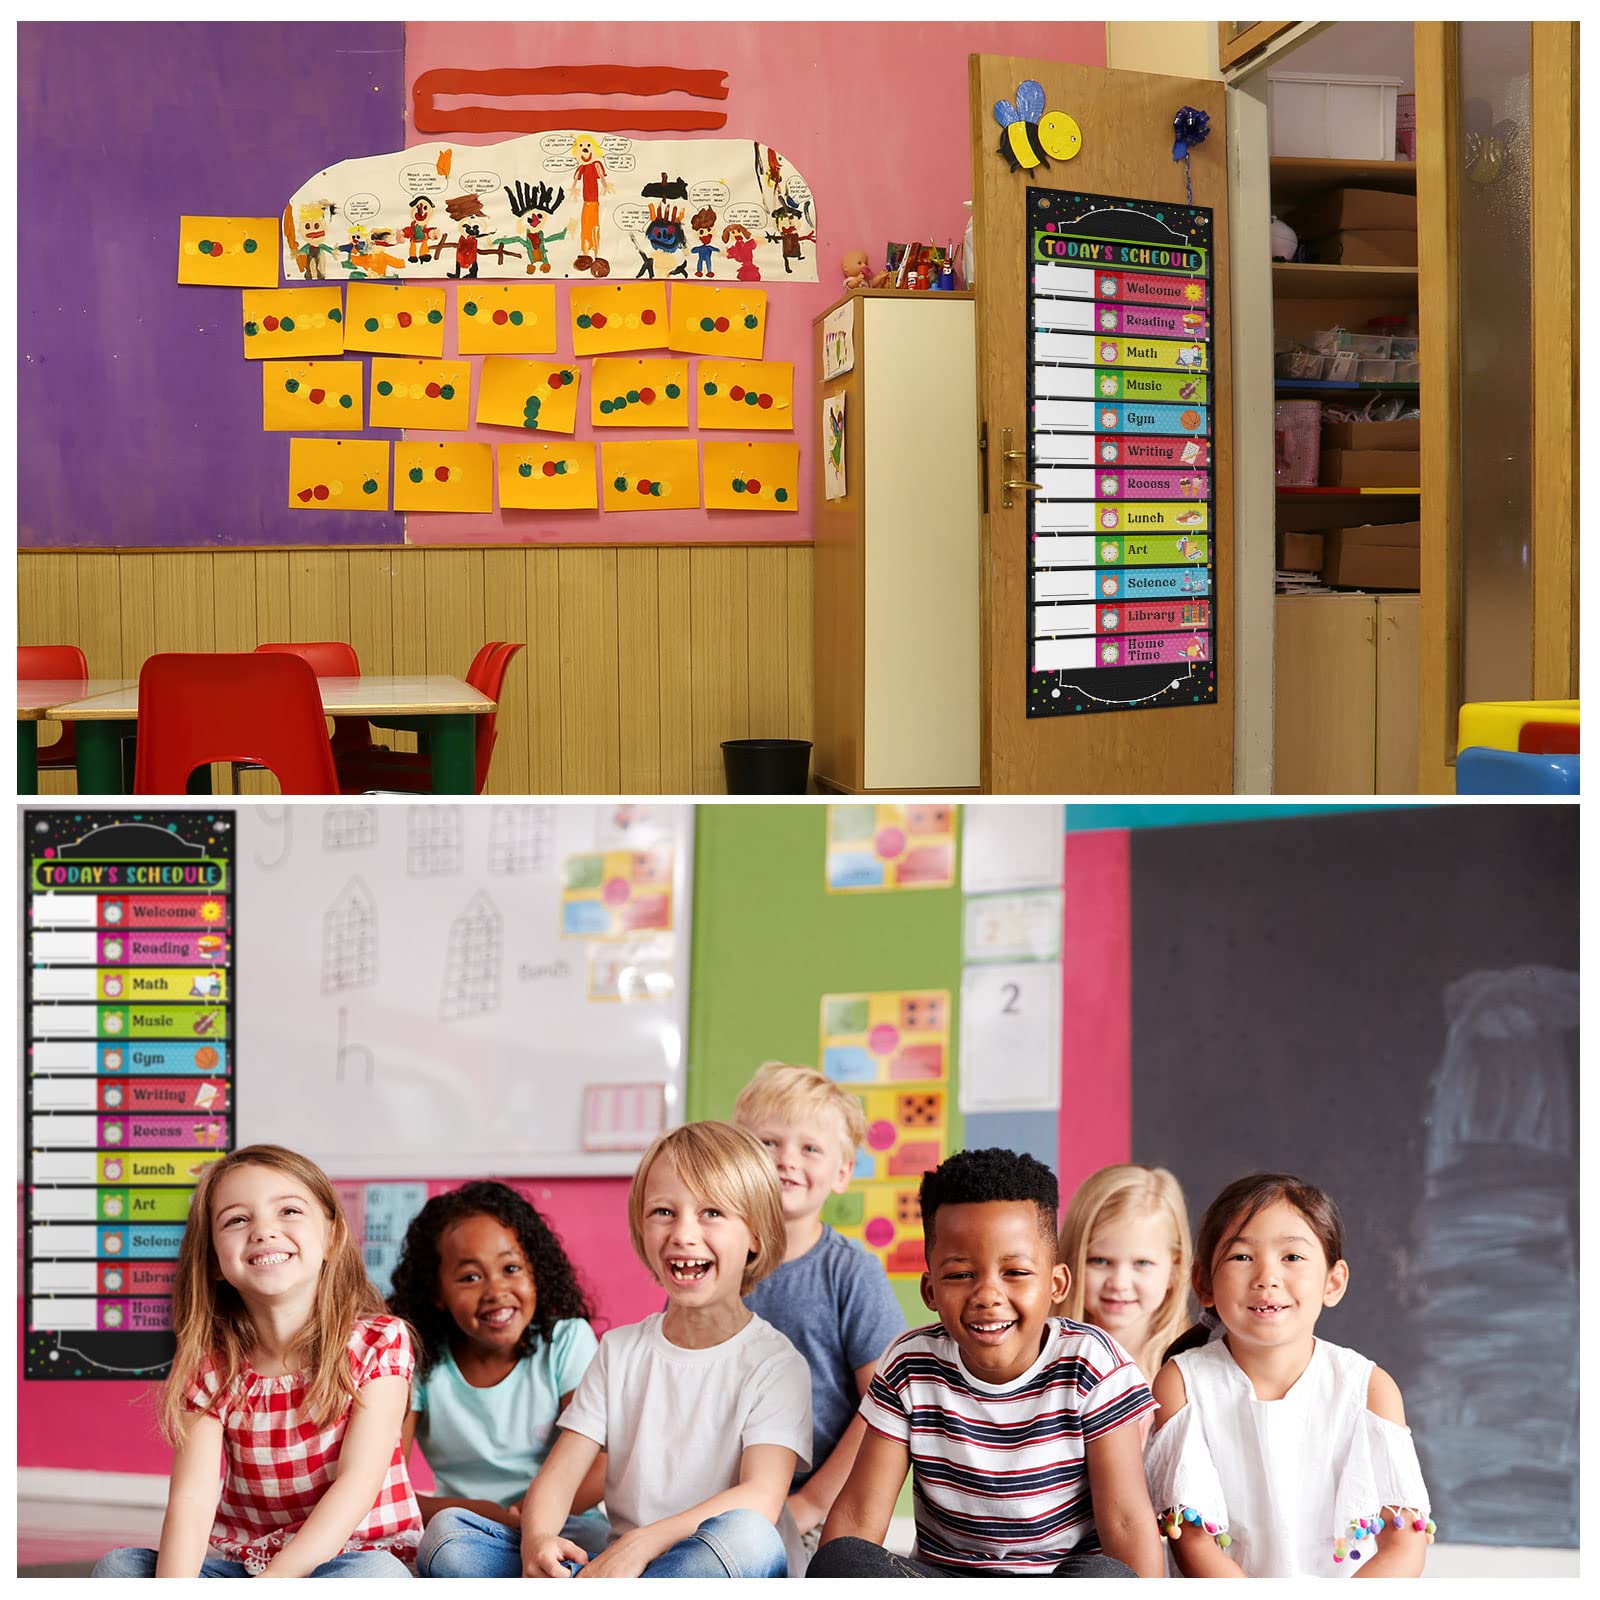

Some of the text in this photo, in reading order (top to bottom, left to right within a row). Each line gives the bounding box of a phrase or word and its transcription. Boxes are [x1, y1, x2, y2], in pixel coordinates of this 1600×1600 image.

[1046, 240, 1198, 269] TODAY'S SCHEDULE
[1126, 282, 1181, 296] Welcome
[1126, 315, 1175, 329] Reading
[1126, 347, 1157, 359] Math
[1127, 380, 1162, 391] Music
[1127, 413, 1155, 426] Gym
[1128, 445, 1173, 459] Writing
[1128, 478, 1170, 489] Recess
[1128, 512, 1164, 523] Lunch
[1128, 545, 1147, 555] Art
[1128, 577, 1176, 588] Science
[1128, 610, 1175, 622] Library
[1128, 639, 1164, 649] Home
[1128, 650, 1160, 660] Time
[44, 867, 217, 883] TODAY'S SCHEDULE
[133, 906, 196, 917] Welcome
[133, 942, 189, 955] Reading
[133, 979, 168, 990] Math
[1001, 982, 1020, 1014] 2
[133, 1015, 173, 1027] Music
[336, 1007, 374, 1085] h
[133, 1052, 165, 1066] Gym
[133, 1089, 186, 1103] Writing
[133, 1126, 182, 1137] Recess
[133, 1164, 175, 1175] Lunch
[133, 1199, 155, 1210] Art
[133, 1235, 183, 1247] Scienc
[133, 1272, 176, 1283] Librar
[132, 1316, 170, 1327] Time
